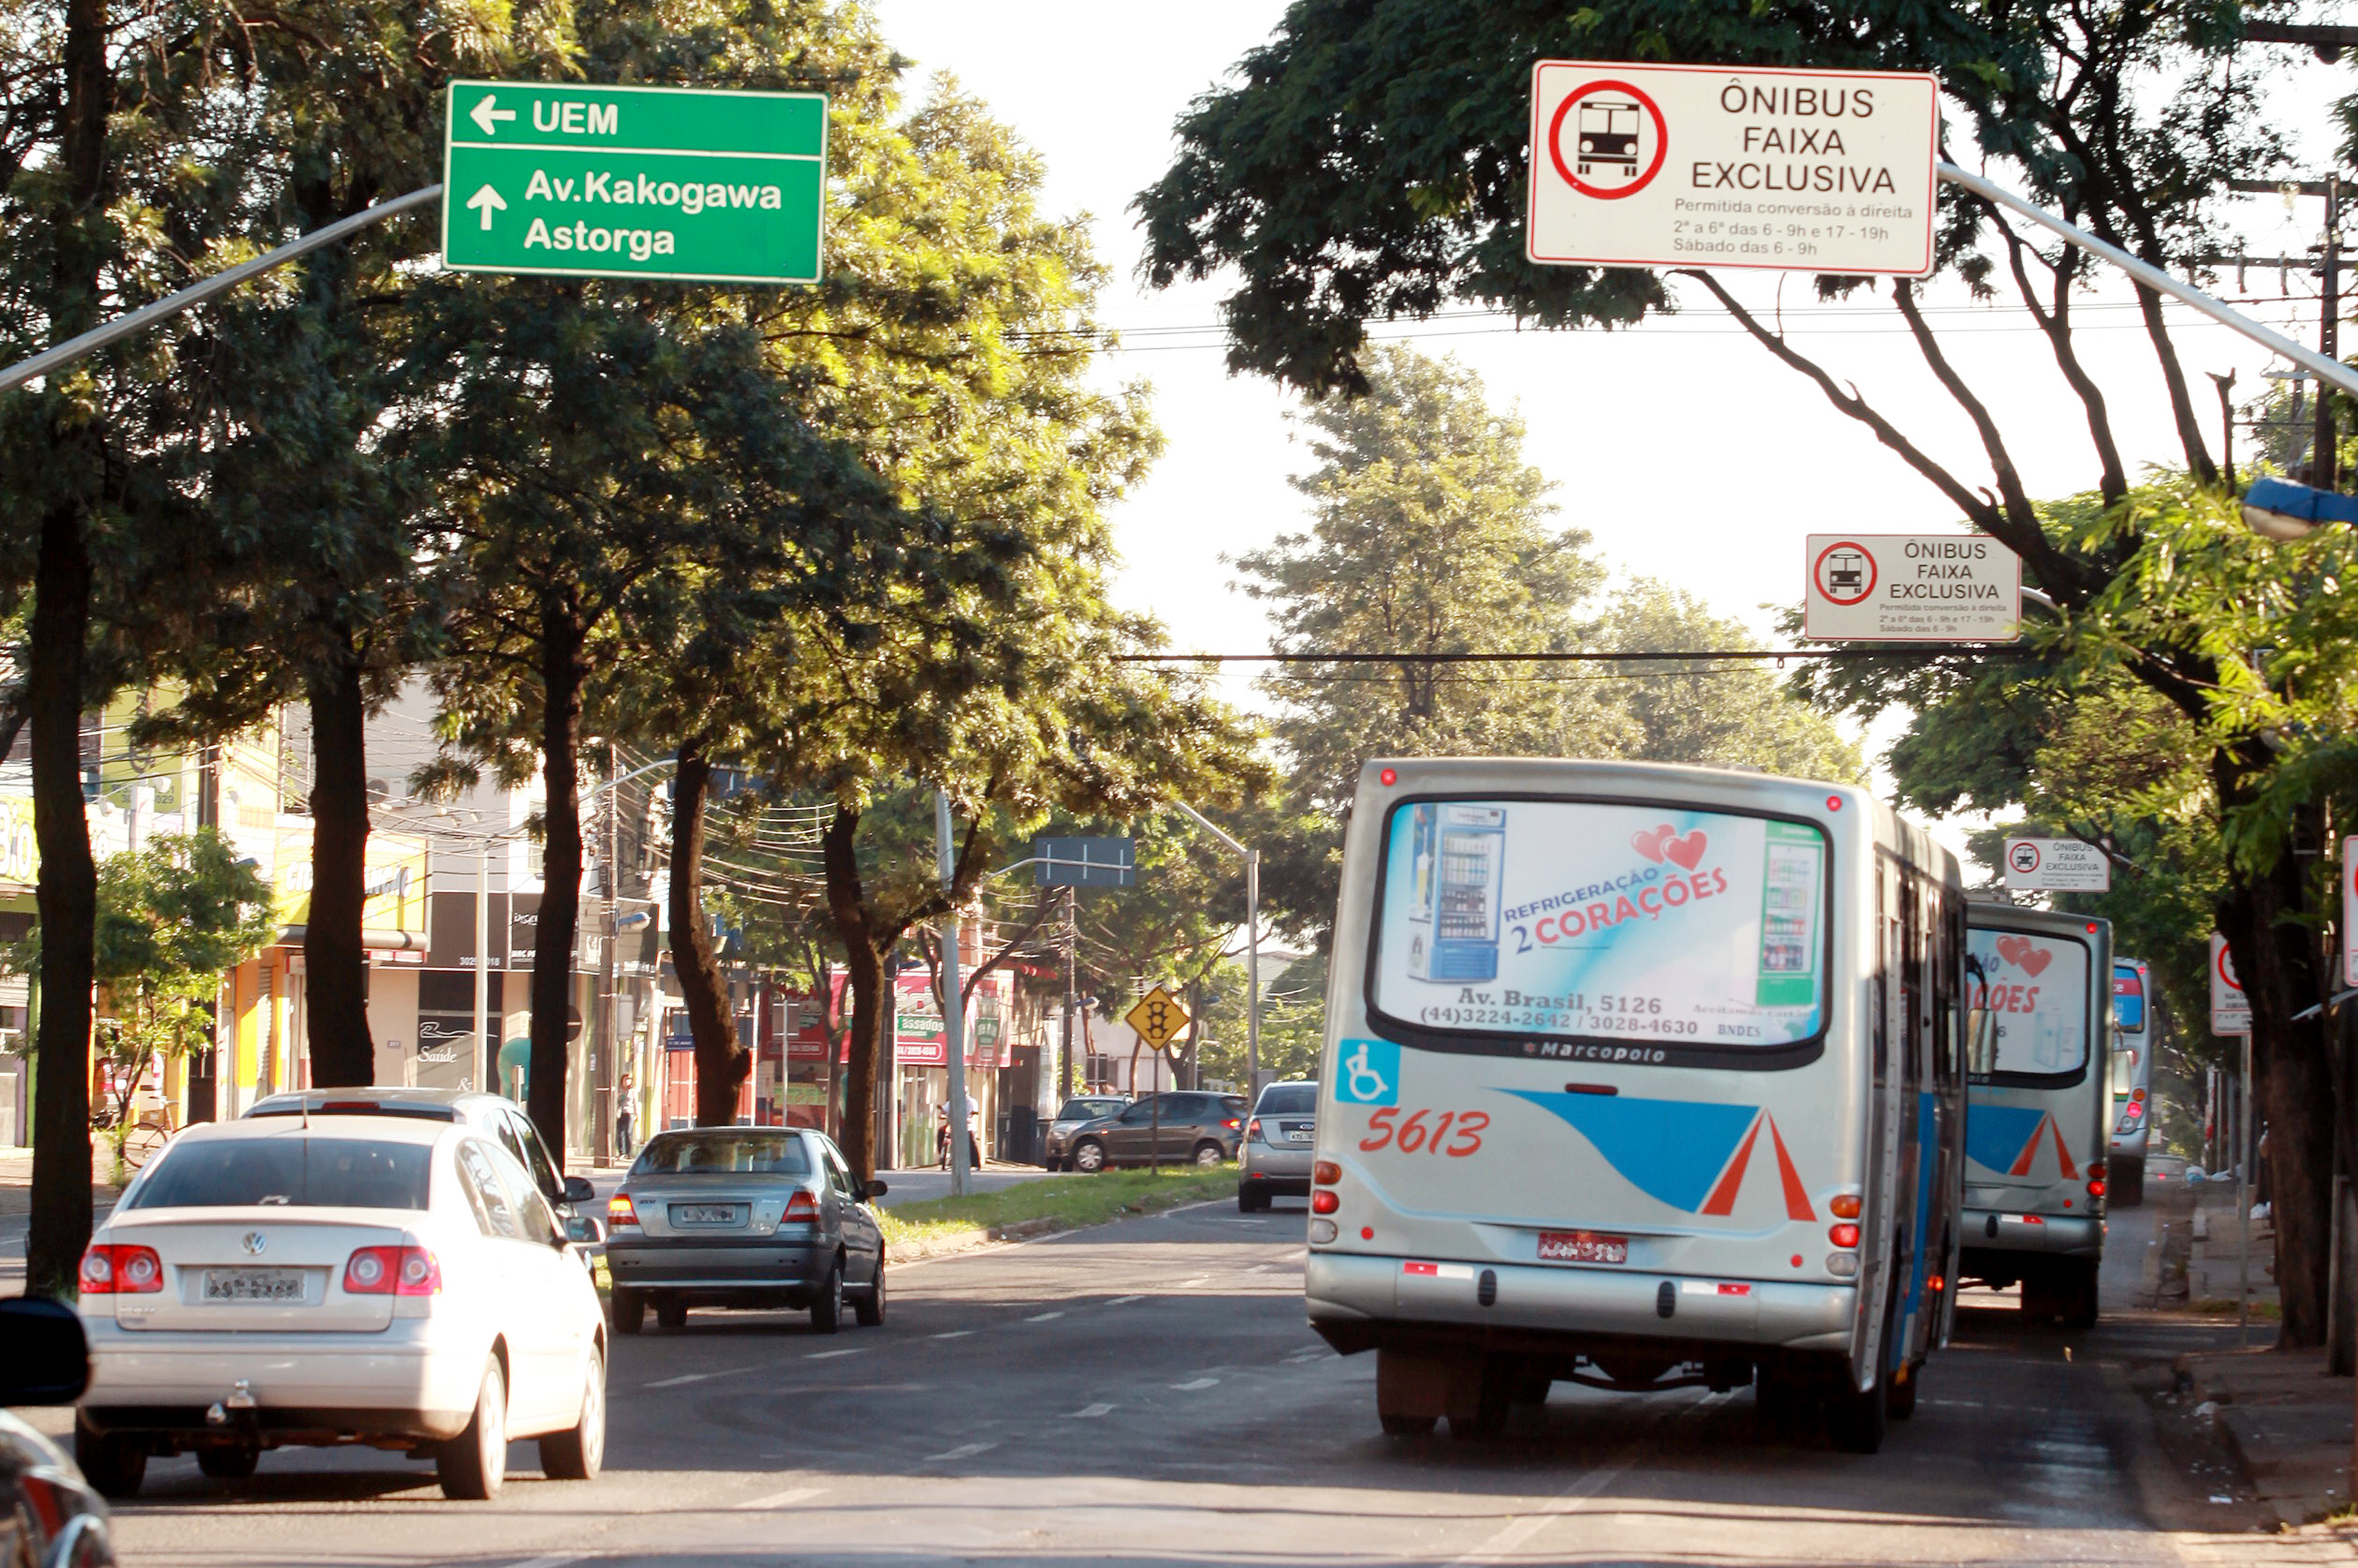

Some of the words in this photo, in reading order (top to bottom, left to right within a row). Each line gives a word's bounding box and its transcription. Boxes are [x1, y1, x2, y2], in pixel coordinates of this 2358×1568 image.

[1720, 78, 1875, 118] ÔNIBUS
[532, 100, 618, 136] UEM
[1743, 127, 1846, 156] FAIXA
[1692, 162, 1896, 194] EXCLUSIVA
[1674, 198, 1753, 215] Permitida
[1757, 203, 1842, 216] conversão
[1860, 203, 1912, 219] direita
[523, 217, 674, 261] Astorga
[1694, 223, 1704, 234] a
[1729, 222, 1758, 236] das
[1763, 223, 1773, 236] 6
[1786, 223, 1807, 238] 9h
[1811, 226, 1821, 238] e
[1826, 226, 1845, 239] 17
[1860, 226, 1889, 240] 19h
[1673, 237, 1735, 253] Sábado
[1740, 239, 1769, 253] das
[1774, 242, 1783, 254] 6
[1797, 242, 1817, 255] 9h
[1904, 539, 1987, 559] ÔNIBUS
[1917, 564, 1972, 579] FAIXA
[1890, 584, 2000, 599] EXCLUSIVA
[2046, 862, 2099, 871] EXCLUSIVA
[1503, 867, 1659, 923] REFRIGERAÇÃO
[1510, 924, 1533, 954] 2
[1535, 867, 1728, 944] CORAÇÕES
[1458, 987, 1496, 1006] Av.
[1503, 990, 1592, 1015] Brasil,
[1600, 996, 1662, 1014] 5126
[901, 1018, 944, 1033] assados
[1420, 1006, 1570, 1029] (44)3224-2642
[1577, 1016, 1584, 1029] /
[1592, 1016, 1698, 1036] 3028-4630
[1717, 1023, 1761, 1037] BNDES
[417, 1046, 457, 1063] Saúde
[1541, 1042, 1665, 1063] Marcopolo
[1359, 1106, 1491, 1158] 5613
